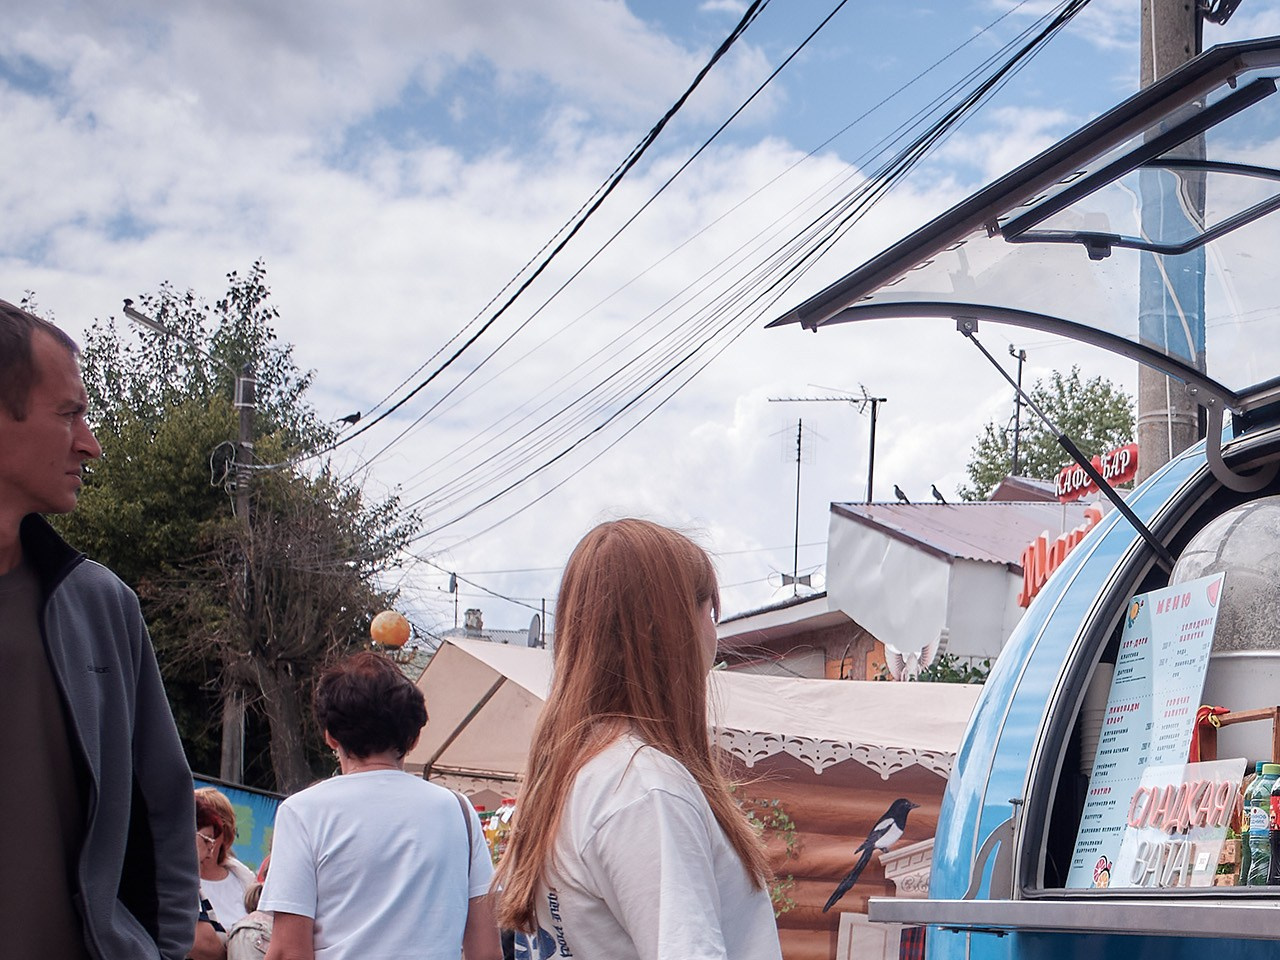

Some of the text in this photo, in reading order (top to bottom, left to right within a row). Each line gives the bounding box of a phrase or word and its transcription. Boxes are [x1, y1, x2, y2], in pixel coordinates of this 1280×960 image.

[1101, 449, 1131, 481] БАР
[1156, 592, 1192, 615] МЕНЮ
[1127, 780, 1234, 835] СЛАДКАЯ
[1130, 840, 1194, 886] ВАТА
